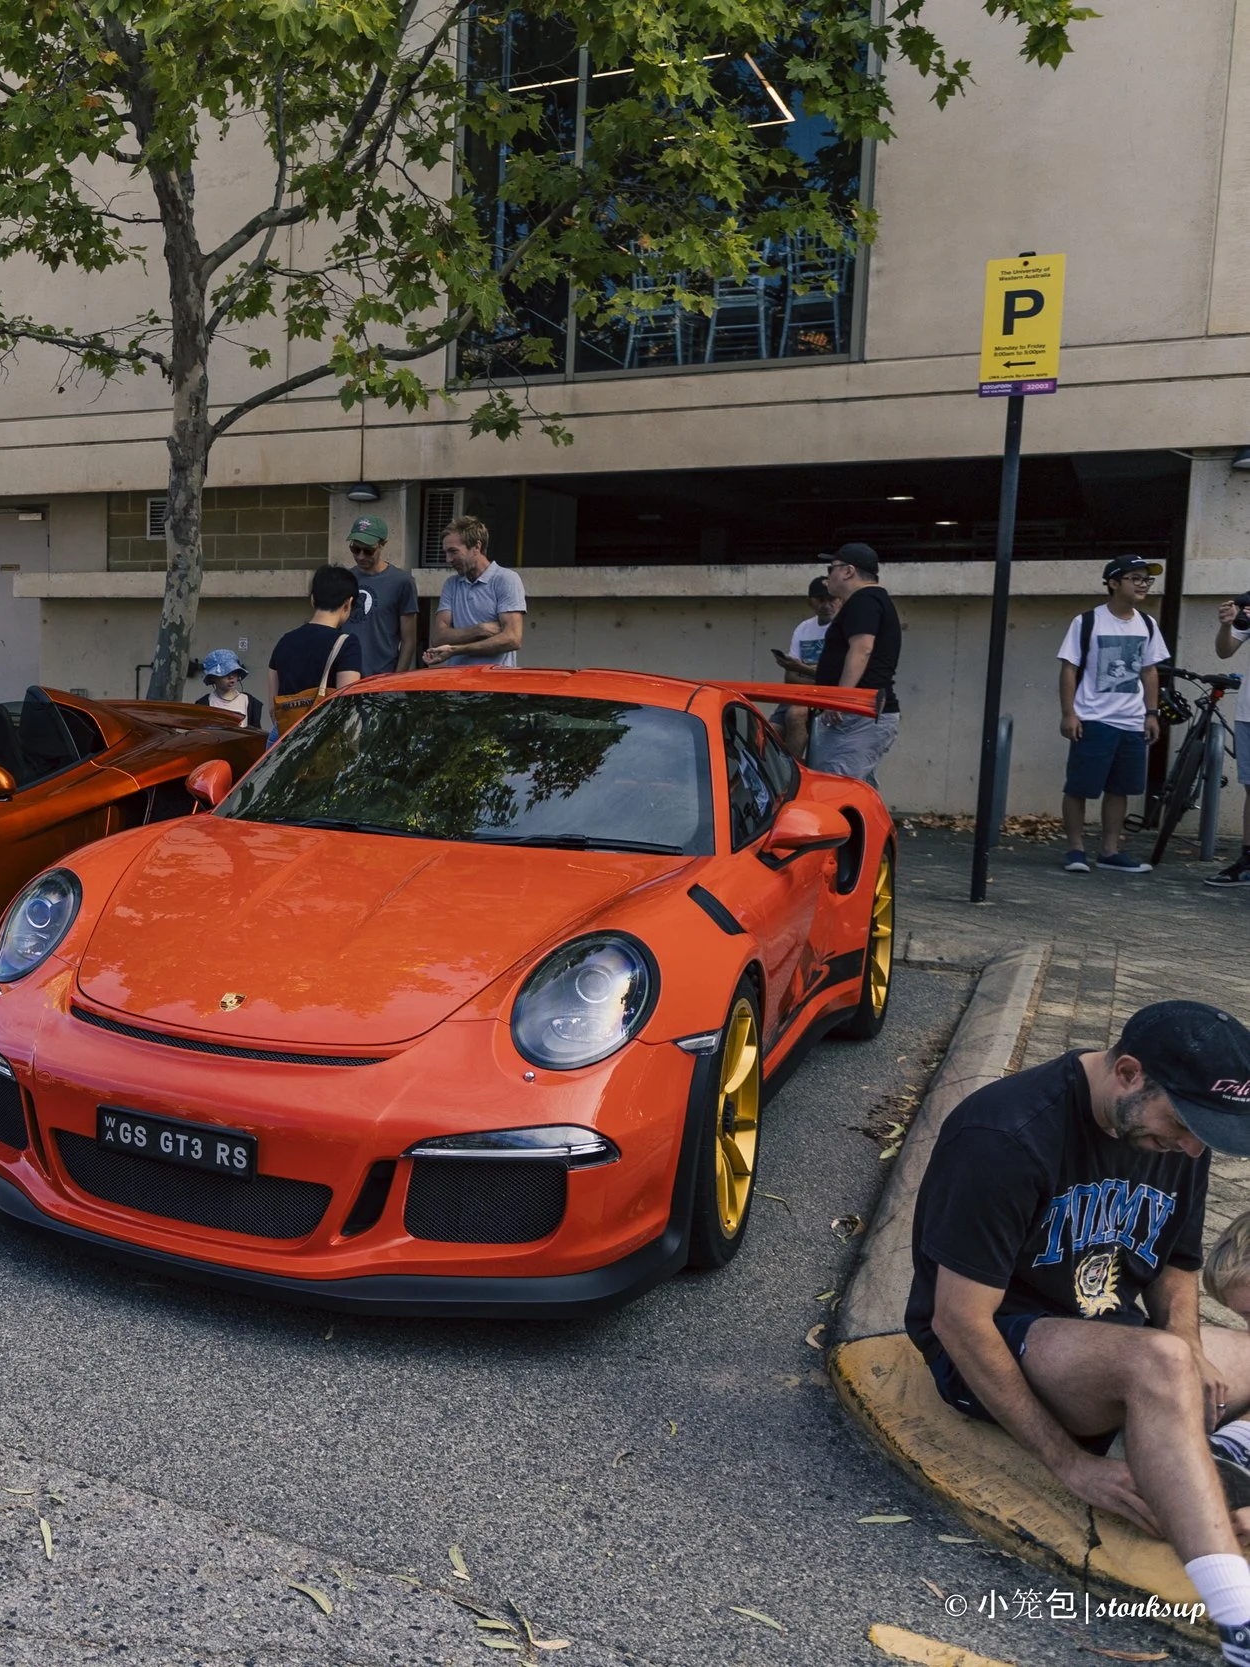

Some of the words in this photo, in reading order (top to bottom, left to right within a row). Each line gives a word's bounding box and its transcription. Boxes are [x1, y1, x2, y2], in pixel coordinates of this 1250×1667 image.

[1002, 289, 1044, 335] P
[119, 1122, 147, 1147] GS
[160, 1131, 202, 1160] GT3
[216, 1142, 247, 1169] RS
